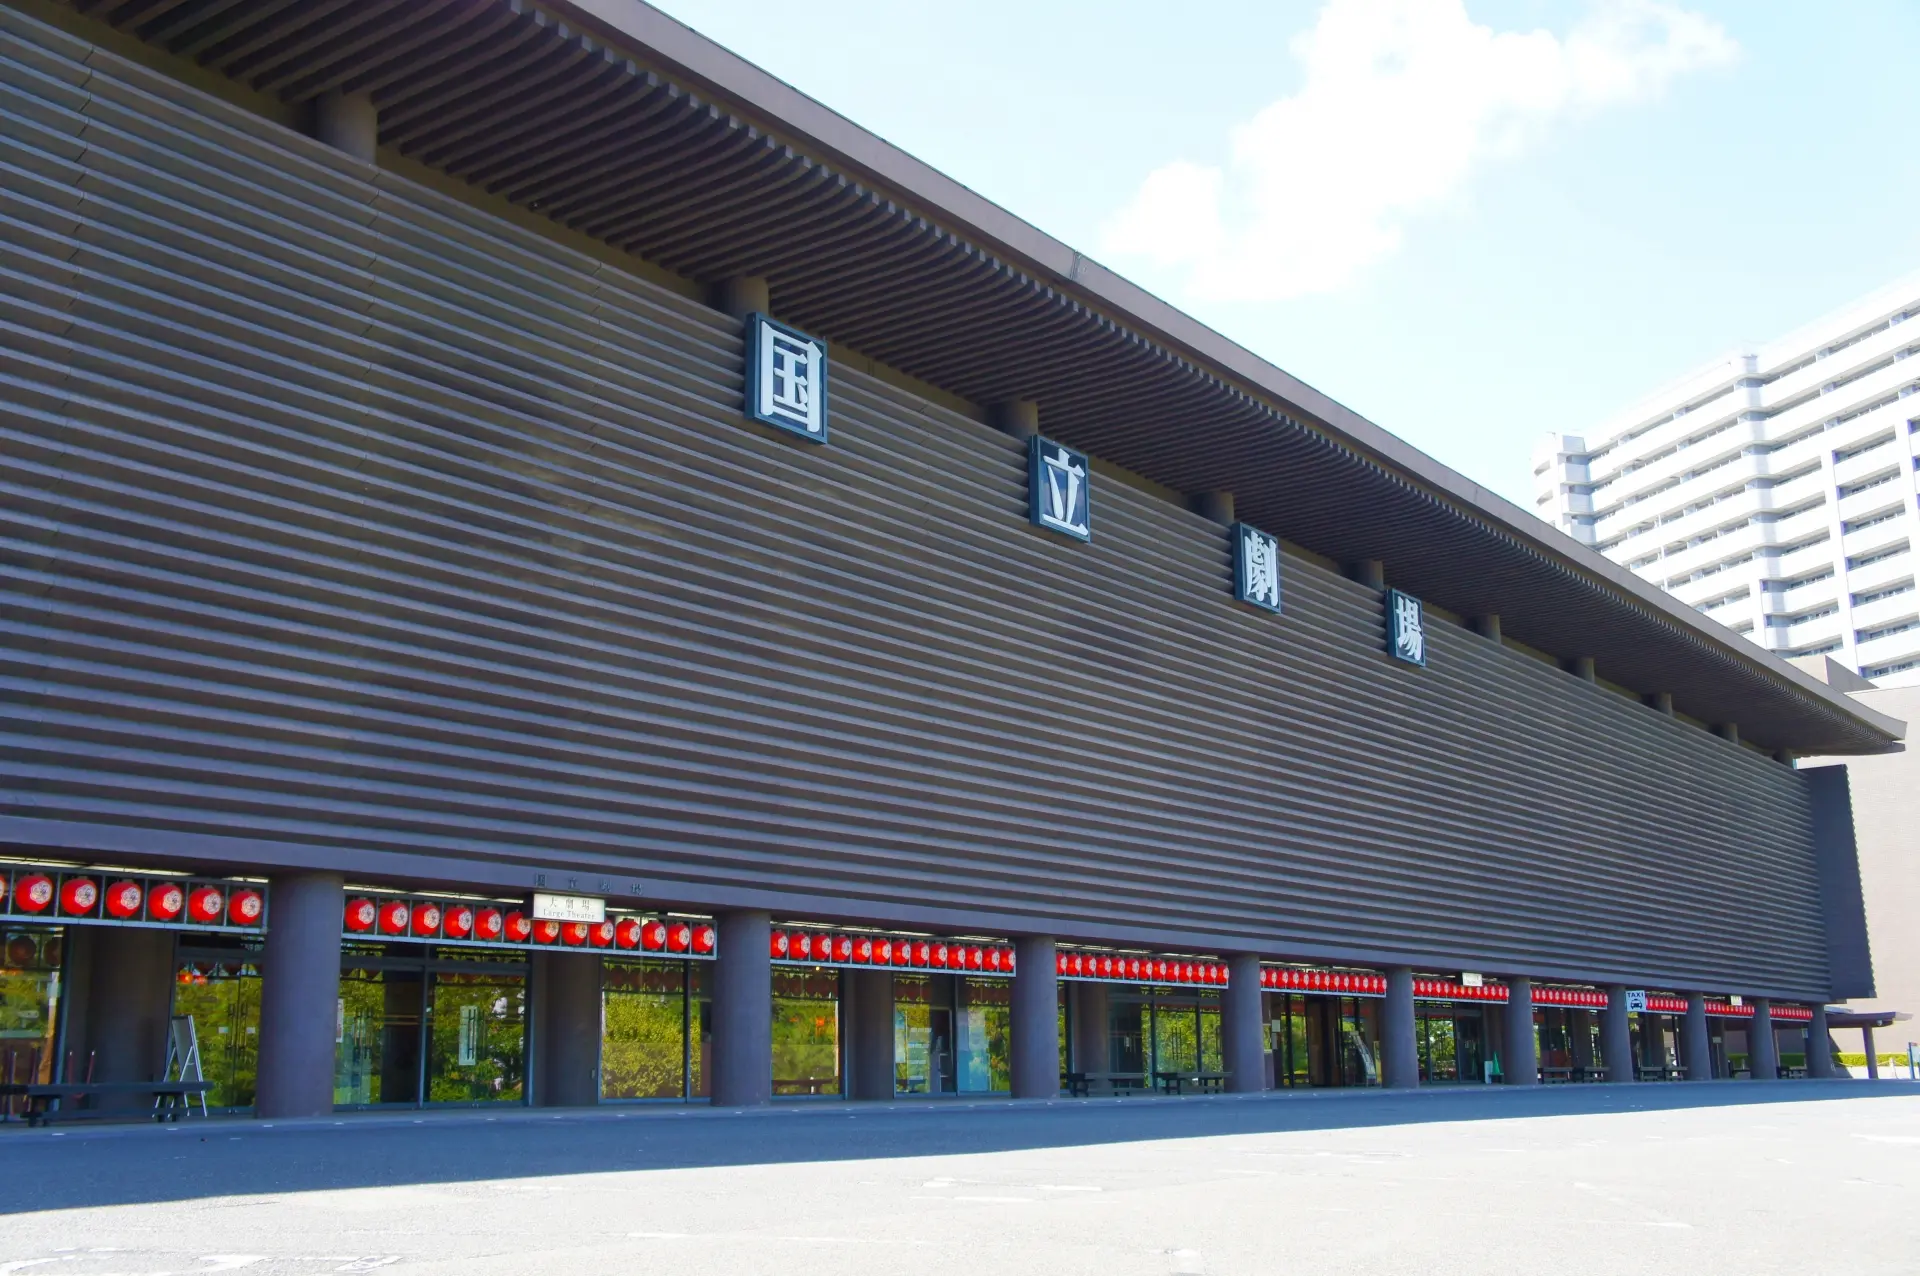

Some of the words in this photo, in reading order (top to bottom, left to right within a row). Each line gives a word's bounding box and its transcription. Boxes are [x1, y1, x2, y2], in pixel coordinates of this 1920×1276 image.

[761, 321, 823, 433] 国
[1042, 447, 1089, 536] 立
[1244, 530, 1279, 607] 劇
[1396, 596, 1423, 661] 場
[543, 908, 565, 918] Large
[567, 910, 596, 920] Theater
